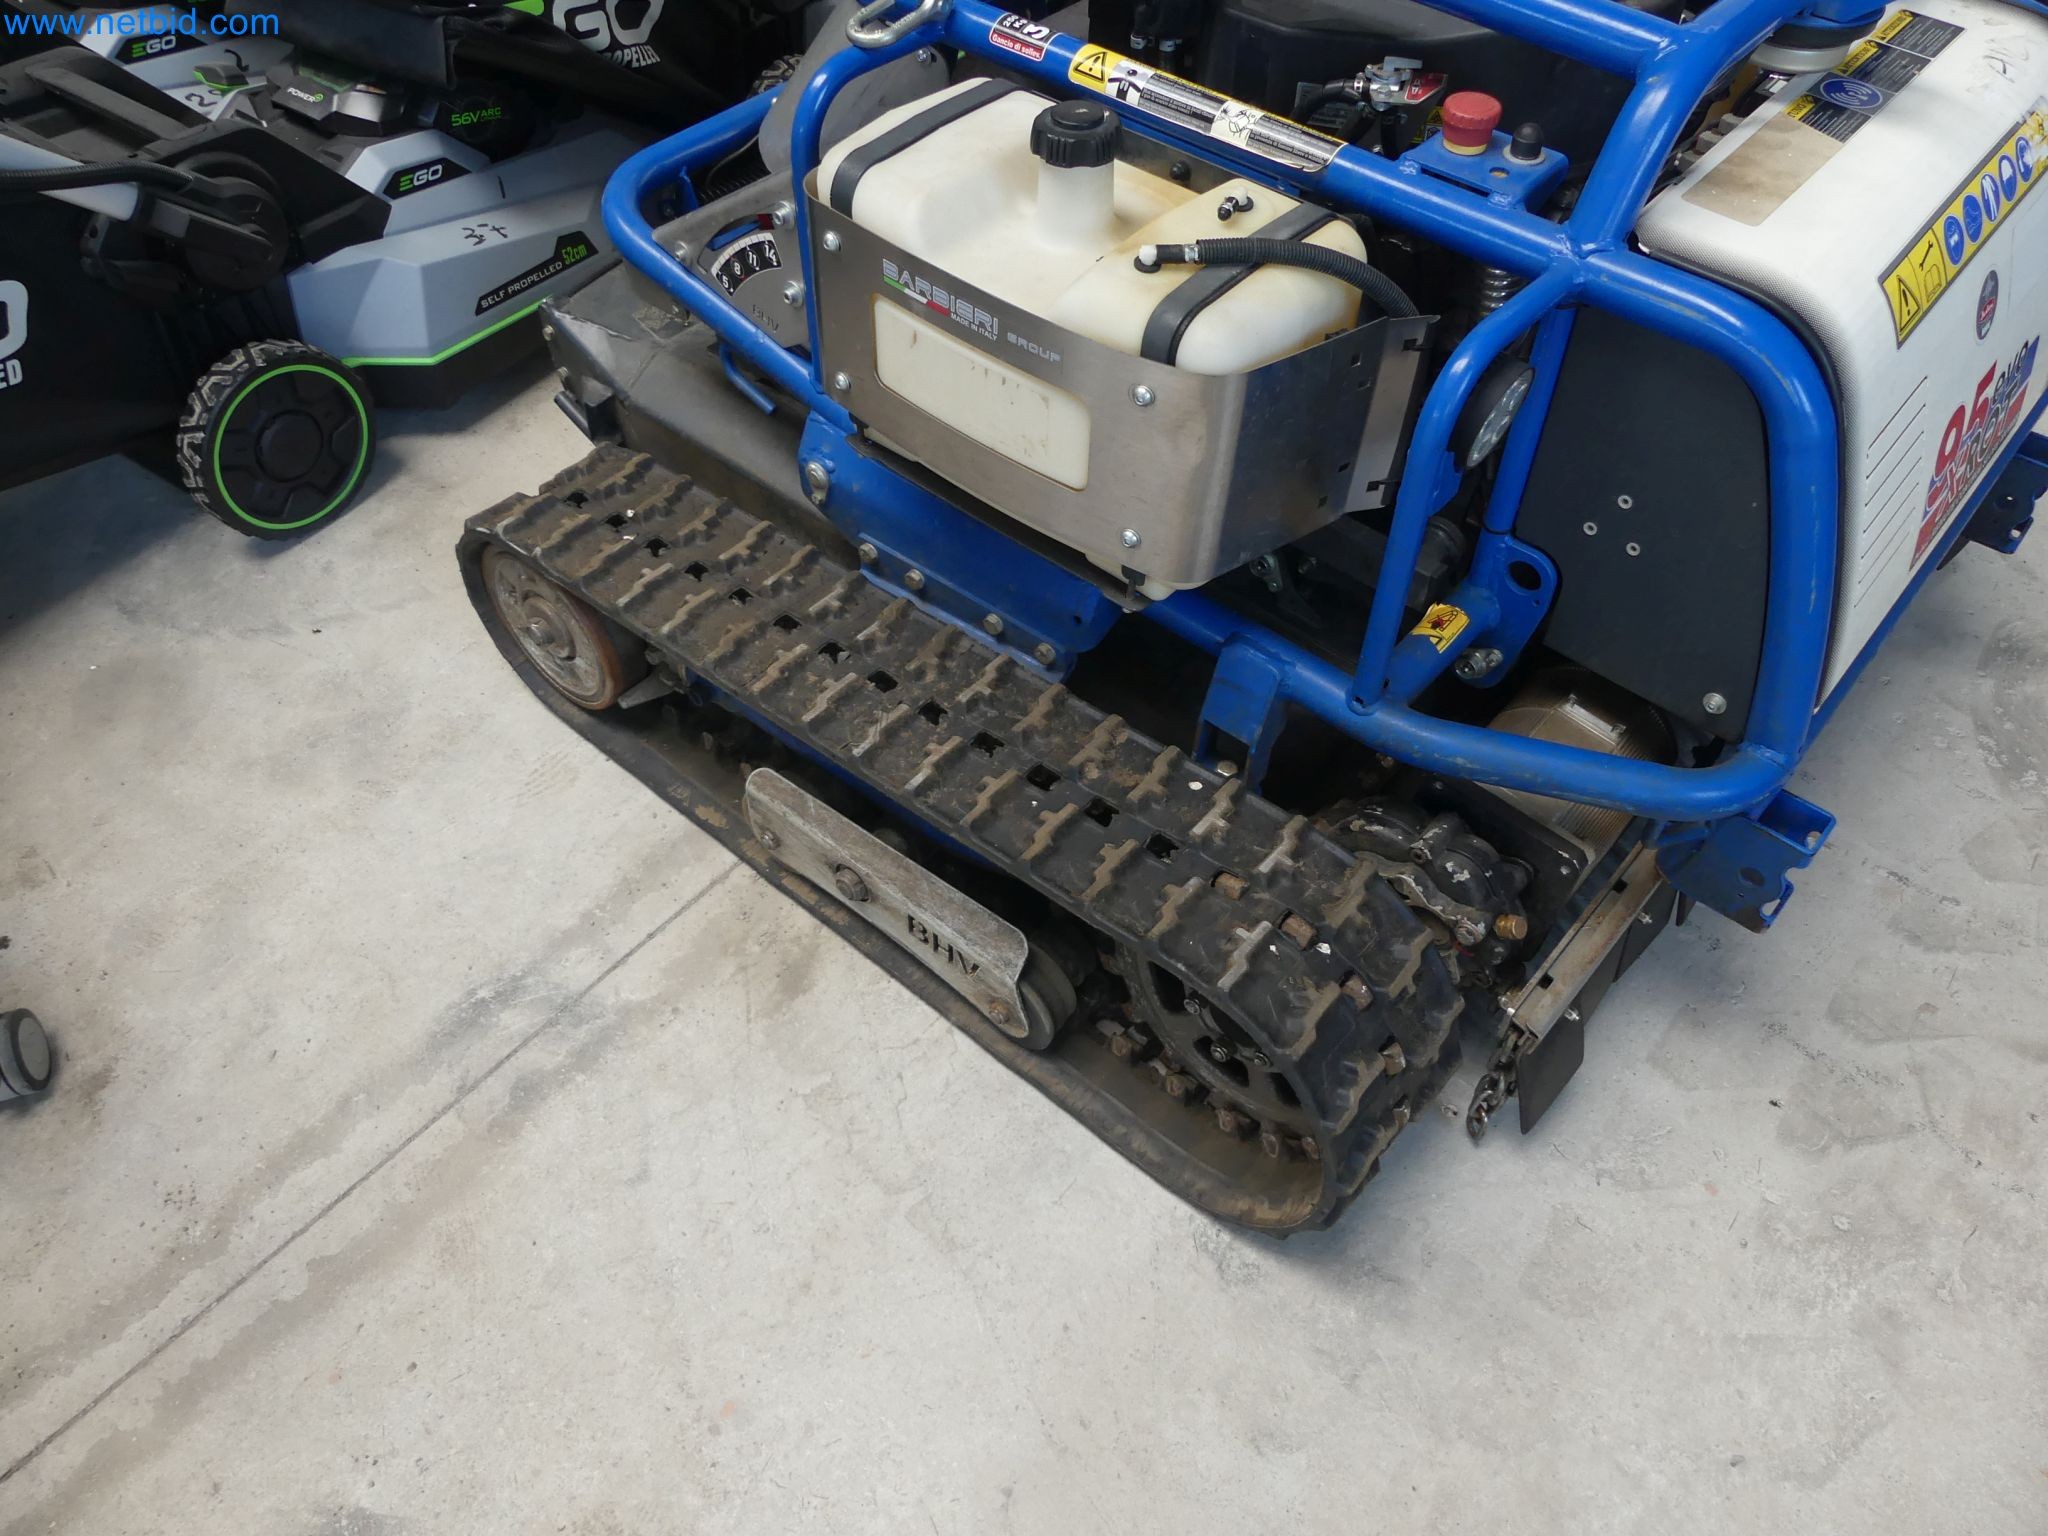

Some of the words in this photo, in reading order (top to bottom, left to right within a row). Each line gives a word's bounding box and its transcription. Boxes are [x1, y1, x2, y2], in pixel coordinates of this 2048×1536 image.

[131, 35, 176, 58] EGO
[1014, 42, 1022, 51] di
[451, 111, 481, 127] 56V
[481, 107, 502, 117] ARC
[399, 164, 443, 192] EGO
[561, 243, 588, 265] 52cm
[748, 250, 757, 267] 11
[764, 244, 776, 263] 14
[733, 262, 741, 275] 8
[480, 290, 506, 308] SELF
[507, 261, 563, 295] PROPELLED
[722, 274, 729, 289] 5
[882, 258, 999, 335] BARBIERI
[1007, 332, 1061, 363] GROUP
[950, 312, 970, 328] MADE
[970, 323, 978, 332] IN
[979, 327, 998, 341] ITALY
